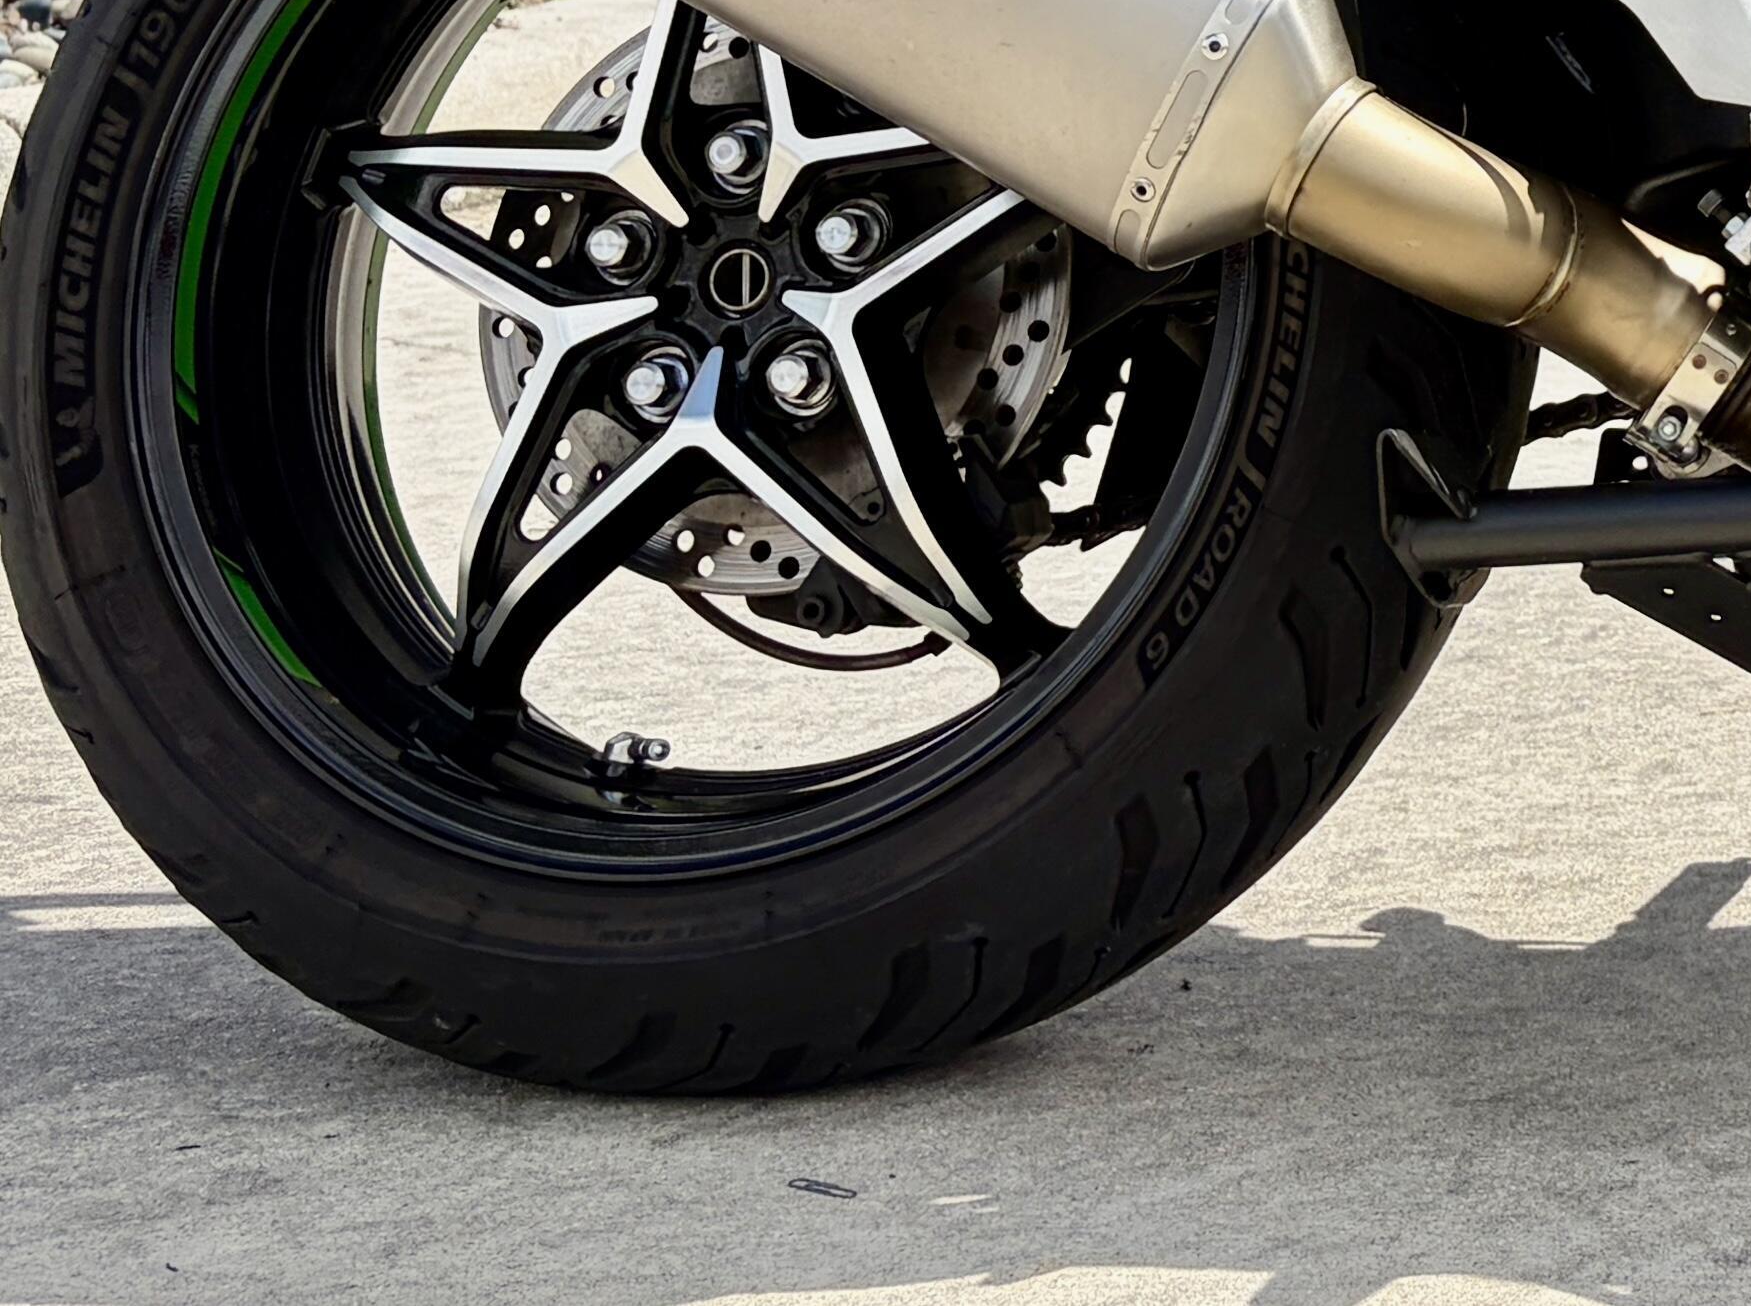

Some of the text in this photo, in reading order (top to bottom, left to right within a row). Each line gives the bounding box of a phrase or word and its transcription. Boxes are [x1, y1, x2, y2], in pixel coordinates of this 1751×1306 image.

[53, 104, 133, 387] MICHELIN
[1257, 240, 1310, 448] CHELIN
[1145, 488, 1253, 672] ROAD 6
